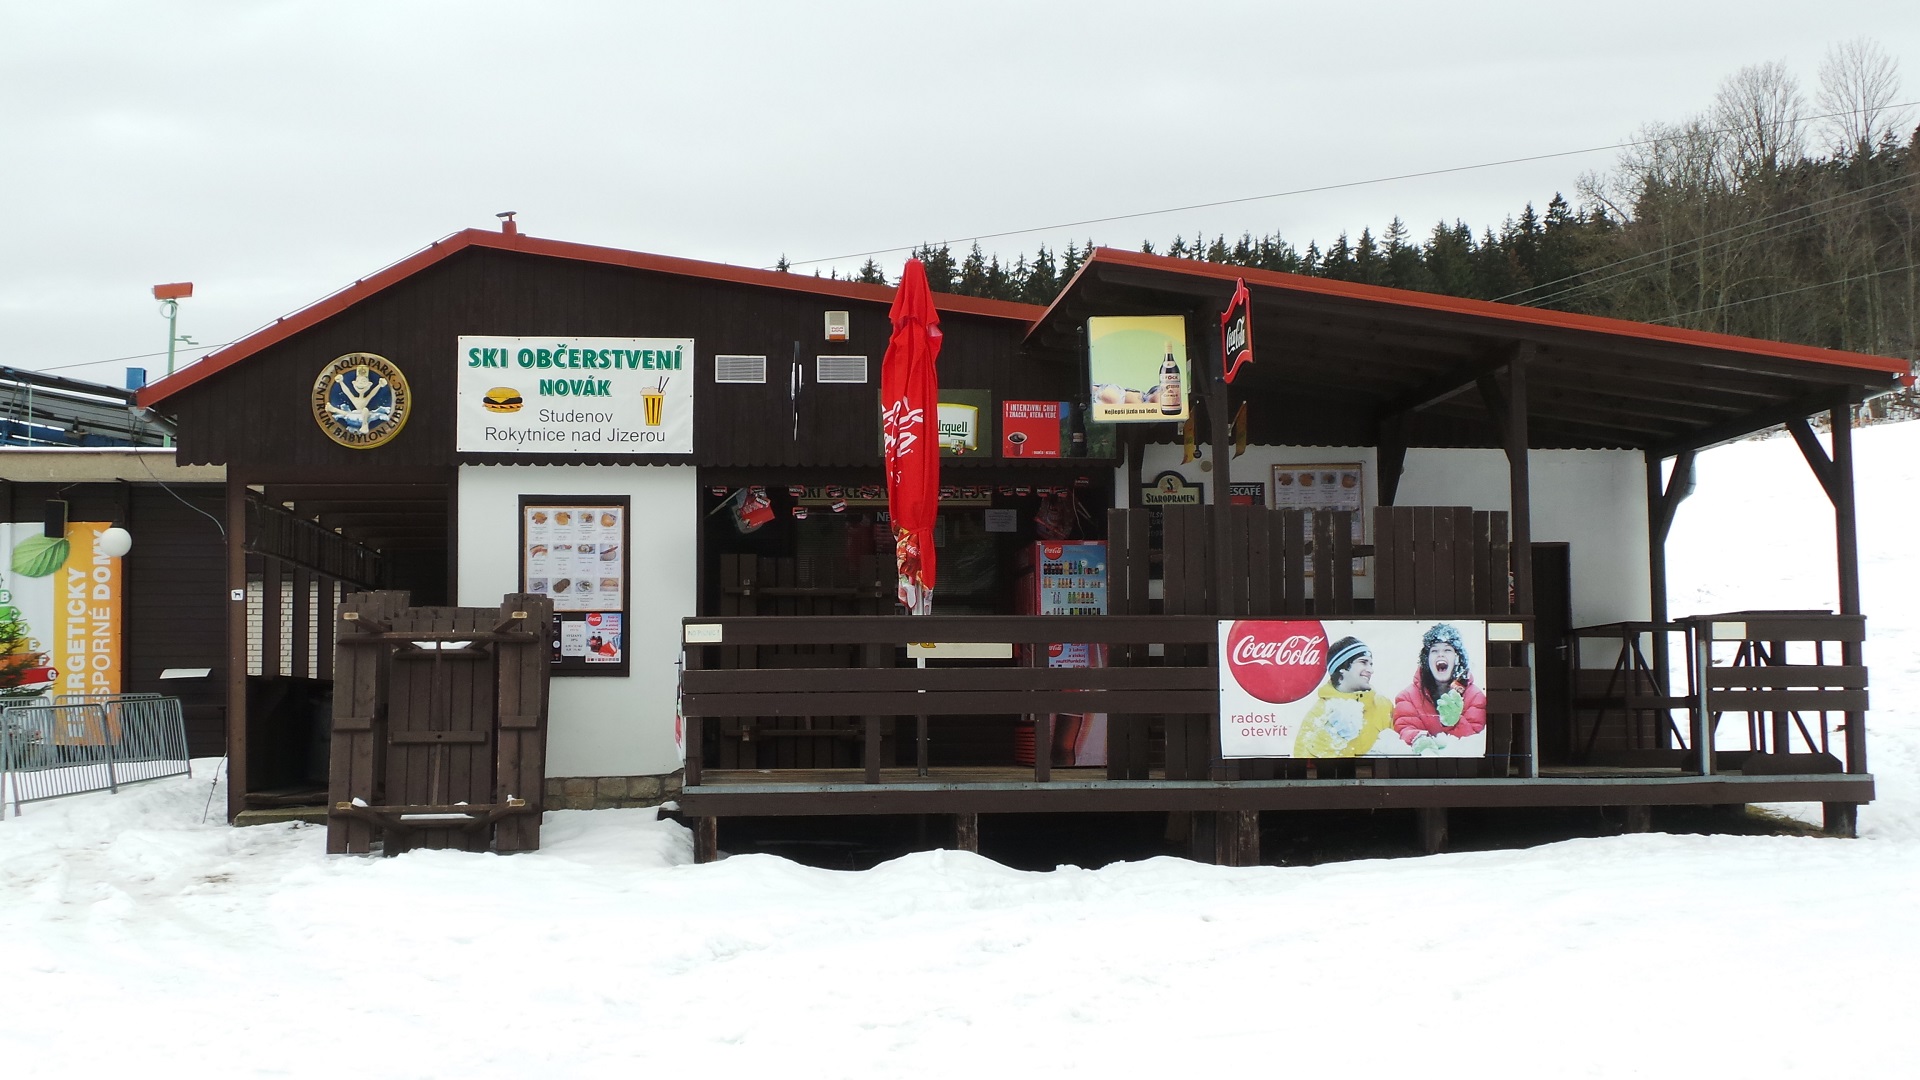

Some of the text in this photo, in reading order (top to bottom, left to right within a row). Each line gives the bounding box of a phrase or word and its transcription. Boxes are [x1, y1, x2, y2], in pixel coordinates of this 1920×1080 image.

[468, 344, 684, 370] SKI OBČERSTVENÍ
[334, 356, 396, 381] AQUAPARK
[539, 375, 612, 398] NOVÁK
[316, 374, 335, 428] CENTRUM
[387, 382, 404, 430] LIBEREC
[539, 408, 613, 423] Studenov
[333, 426, 388, 443] BABYLON
[485, 426, 665, 444] Rokytnice nad Jizerou
[1146, 492, 1196, 504] STAROPRAMEN
[1232, 634, 1324, 666] Coca-Cola
[1230, 712, 1276, 724] radost
[1241, 725, 1288, 738] otevřít
